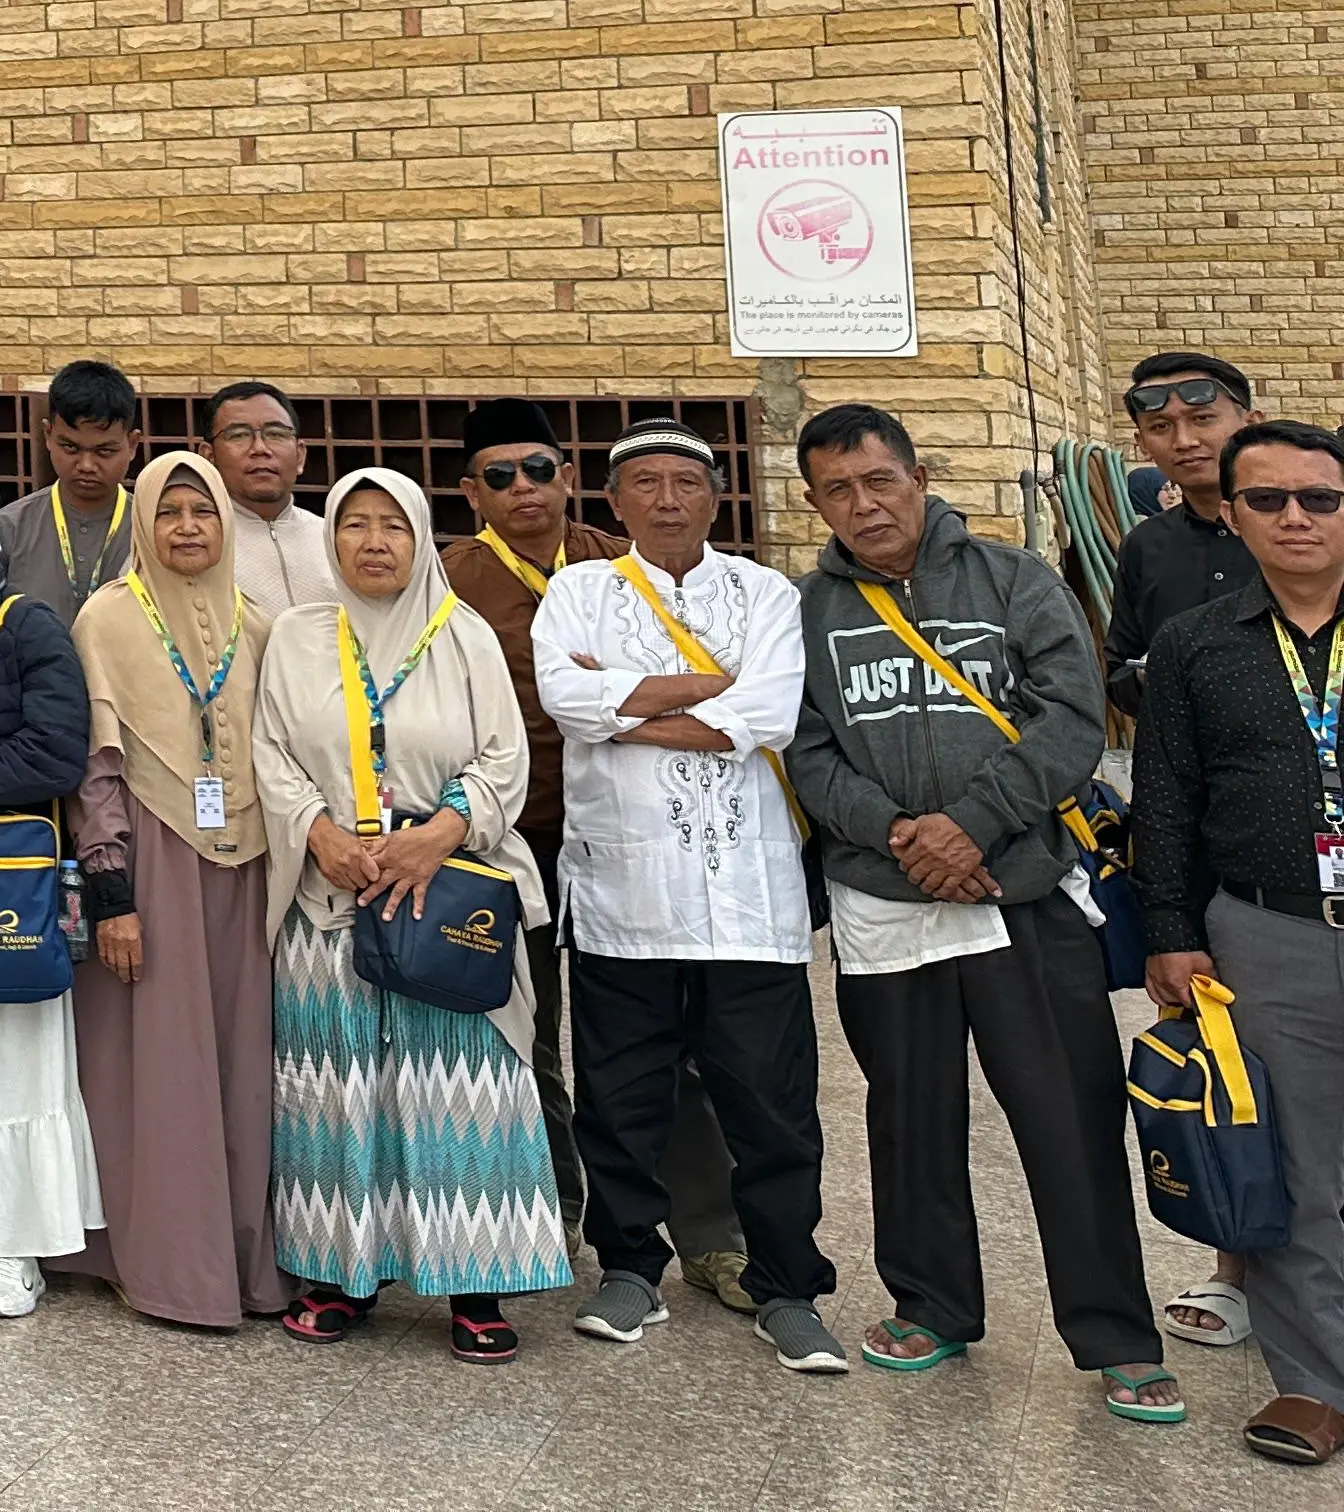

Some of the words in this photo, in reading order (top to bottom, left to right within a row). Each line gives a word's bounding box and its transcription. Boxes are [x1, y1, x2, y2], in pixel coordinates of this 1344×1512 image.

[733, 144, 889, 170] Attention
[739, 293, 804, 308] بالكاميرات
[807, 292, 855, 308] مراقب
[858, 293, 903, 308] المكان
[740, 310, 757, 319] The
[759, 311, 785, 320] place
[786, 311, 795, 319] is
[797, 310, 845, 319] monitored
[848, 310, 860, 320] by
[862, 311, 904, 319] cameras
[844, 657, 914, 704] JUST
[2, 935, 44, 944] RAUDHAH
